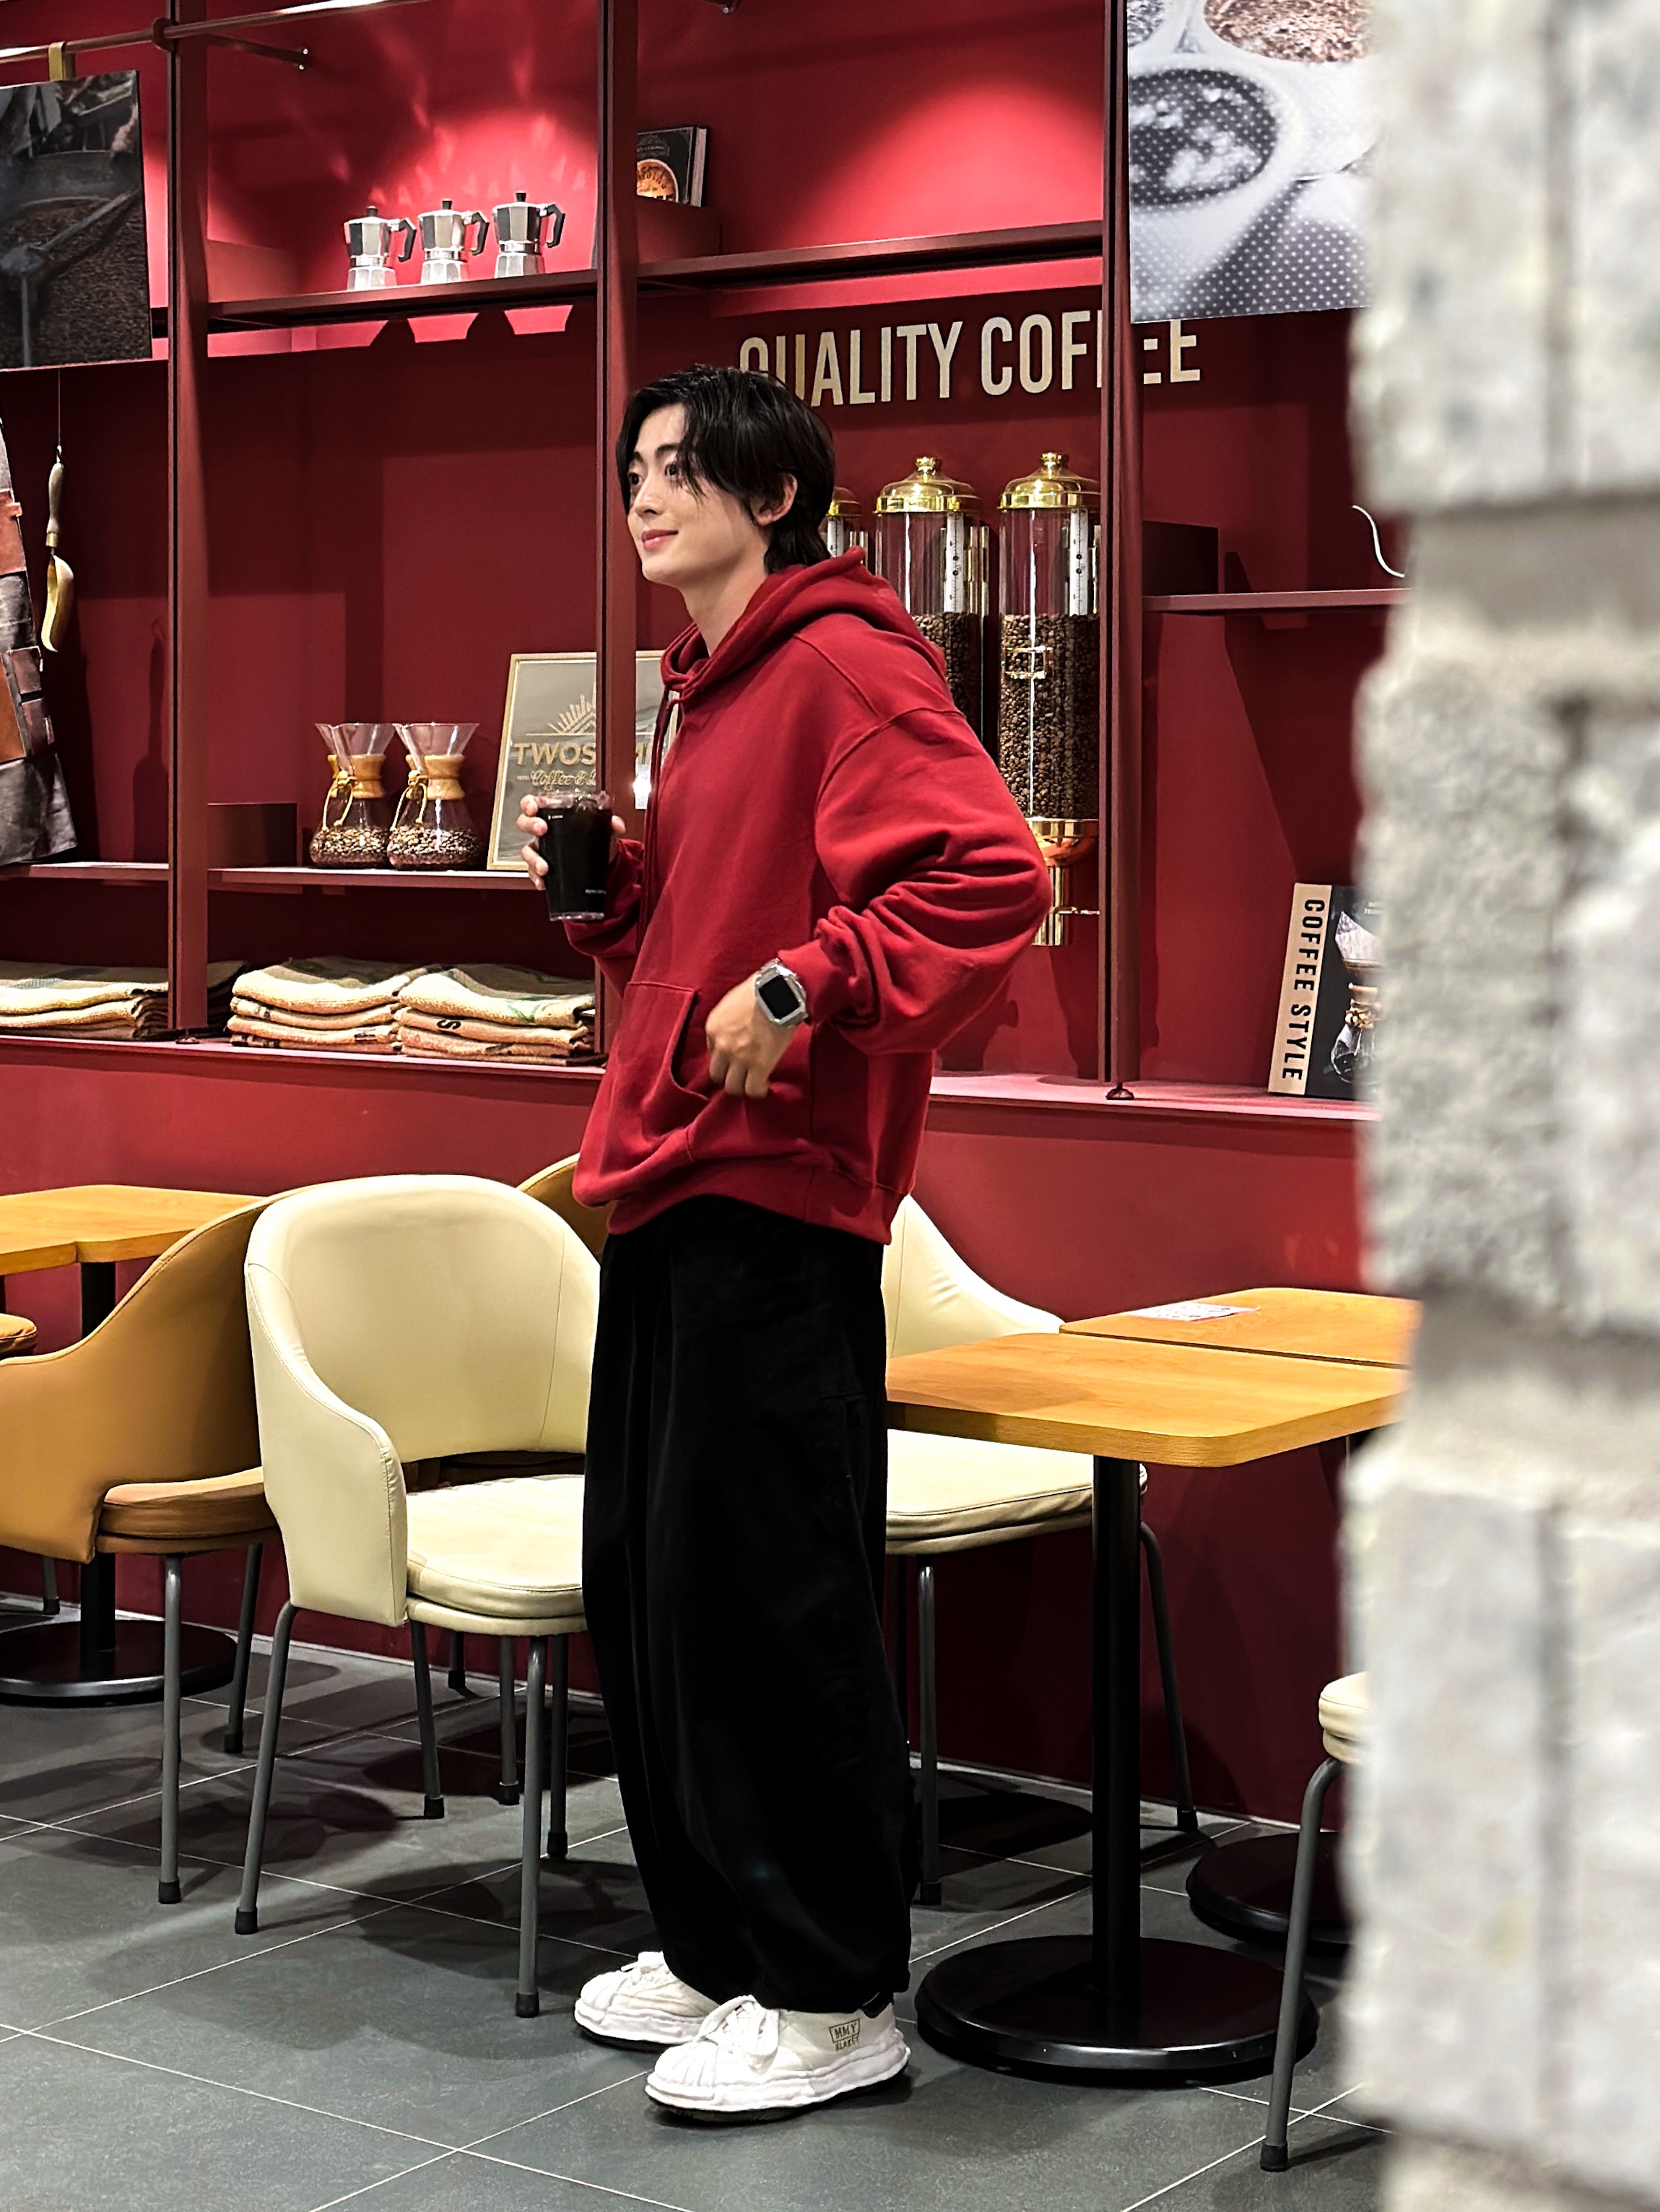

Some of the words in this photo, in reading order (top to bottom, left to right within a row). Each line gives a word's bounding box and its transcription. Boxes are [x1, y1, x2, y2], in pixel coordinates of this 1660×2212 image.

[981, 310, 1200, 395] COFE
[513, 742, 651, 766] TWOS
[531, 770, 575, 791] Coffee
[1293, 899, 1325, 991] COFFEE
[1282, 1004, 1311, 1080] STYLE
